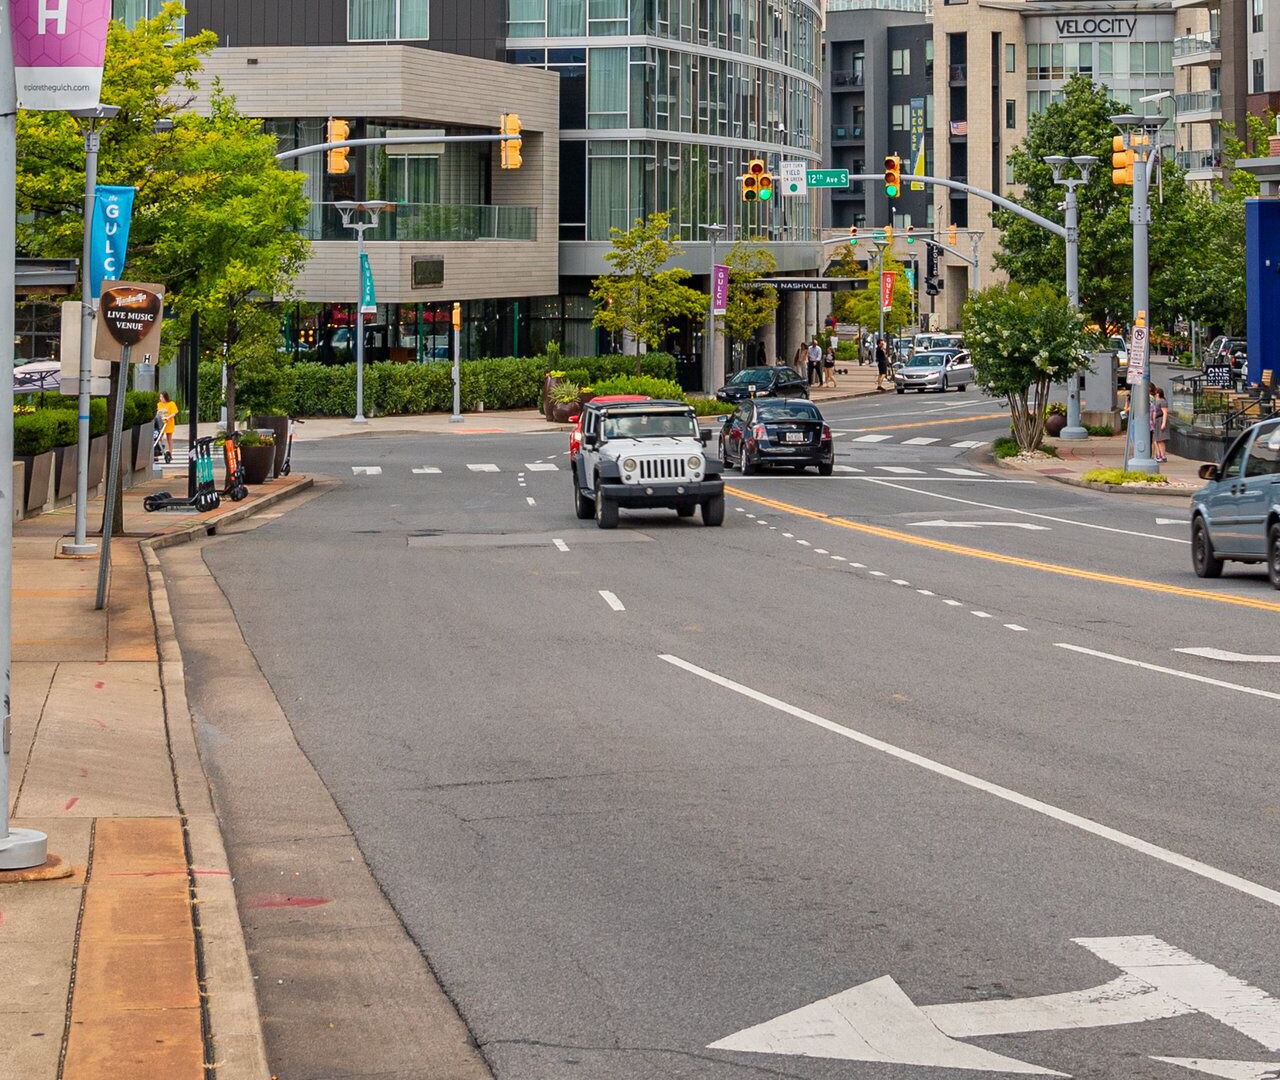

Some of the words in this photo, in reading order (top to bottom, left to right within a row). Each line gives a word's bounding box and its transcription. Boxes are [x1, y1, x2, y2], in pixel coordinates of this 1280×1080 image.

[1055, 18, 1137, 37] VELOCITY
[808, 173, 824, 184] 12th
[840, 173, 847, 183] S
[716, 272, 724, 306] GULCH
[780, 282, 828, 290] NASHVILLE
[107, 310, 127, 320] LIVE
[127, 312, 154, 322] MUSIC
[116, 321, 144, 331] VENUE
